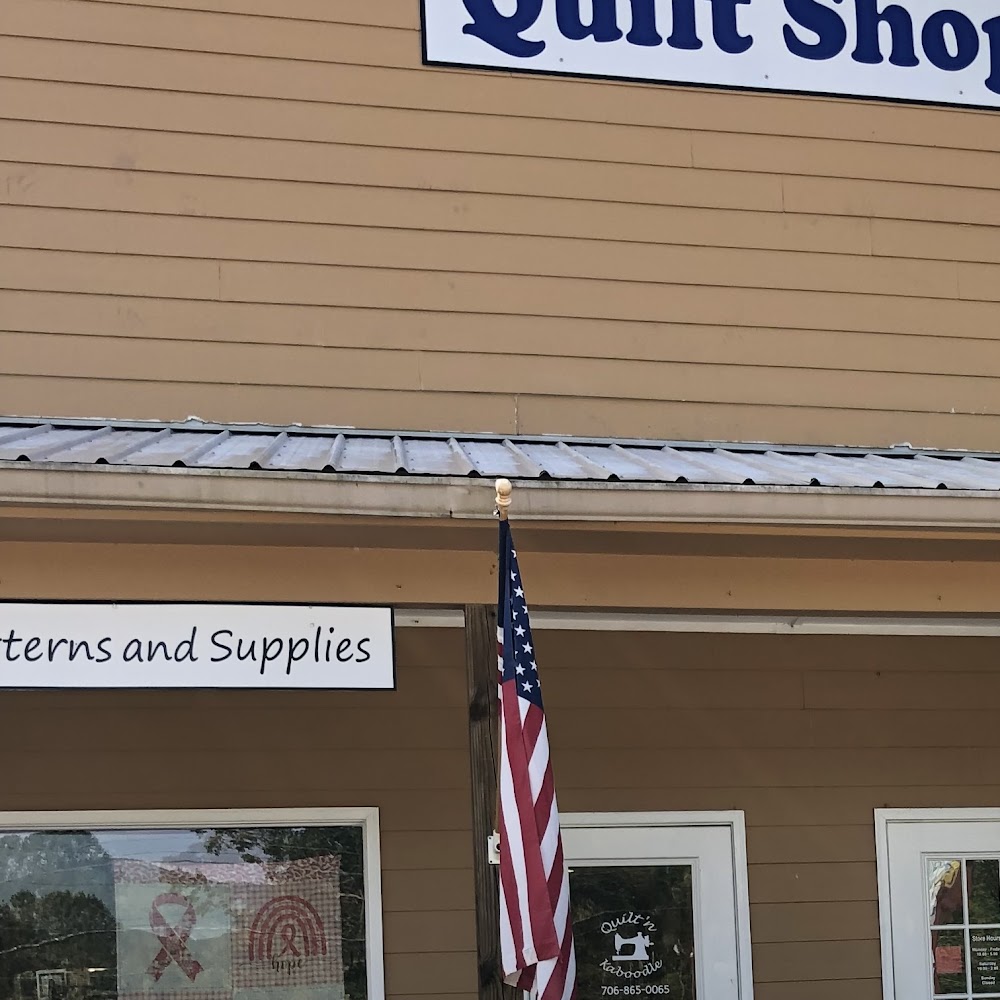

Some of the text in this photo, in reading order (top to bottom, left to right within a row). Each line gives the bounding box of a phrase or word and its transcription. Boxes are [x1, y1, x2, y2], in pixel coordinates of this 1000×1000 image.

[0, 626, 372, 675] terns and Supplies
[599, 958, 664, 979] Kaboodle
[600, 984, 671, 996] 706-865-0065
